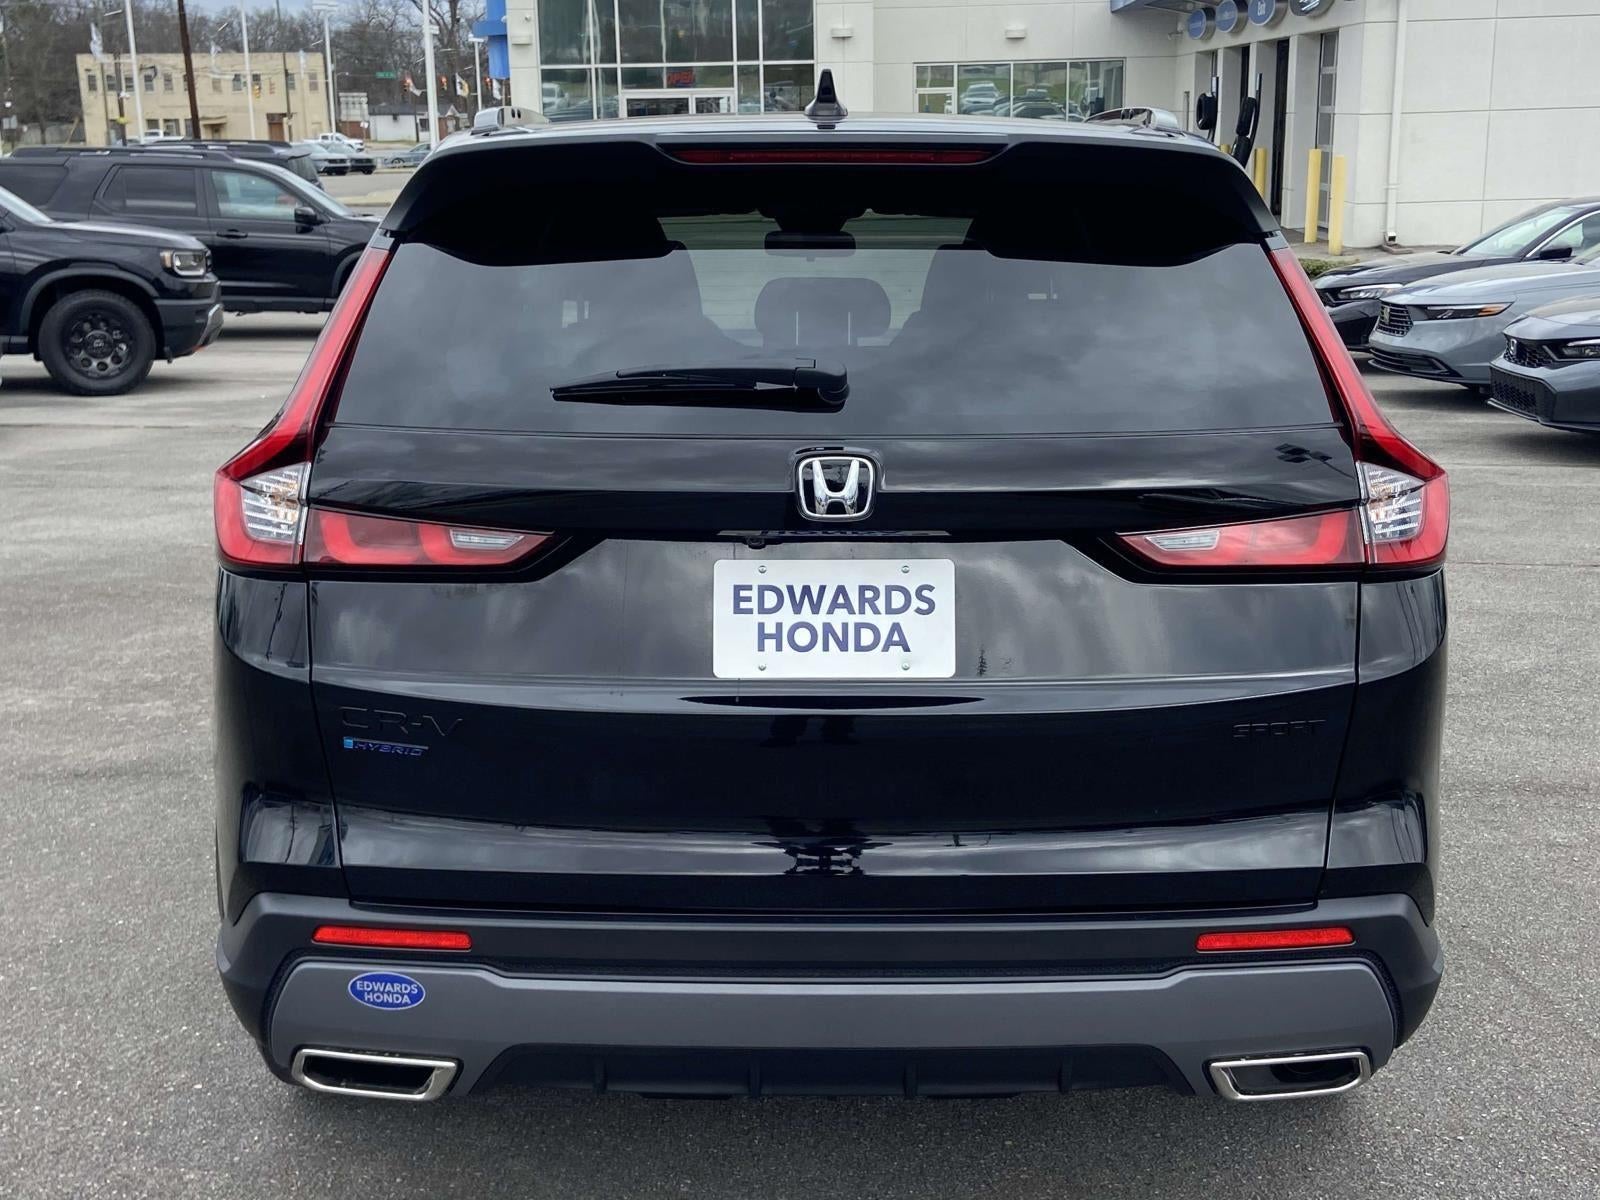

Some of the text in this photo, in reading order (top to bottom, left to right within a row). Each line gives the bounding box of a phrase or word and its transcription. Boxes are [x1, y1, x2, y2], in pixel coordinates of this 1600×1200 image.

[733, 584, 936, 616] EDWARDS
[757, 621, 911, 652] HONDA
[340, 706, 463, 736] CR-V
[1232, 719, 1327, 737] SPORT
[356, 981, 418, 994] EDWARDS
[364, 992, 411, 1004] HONDA
